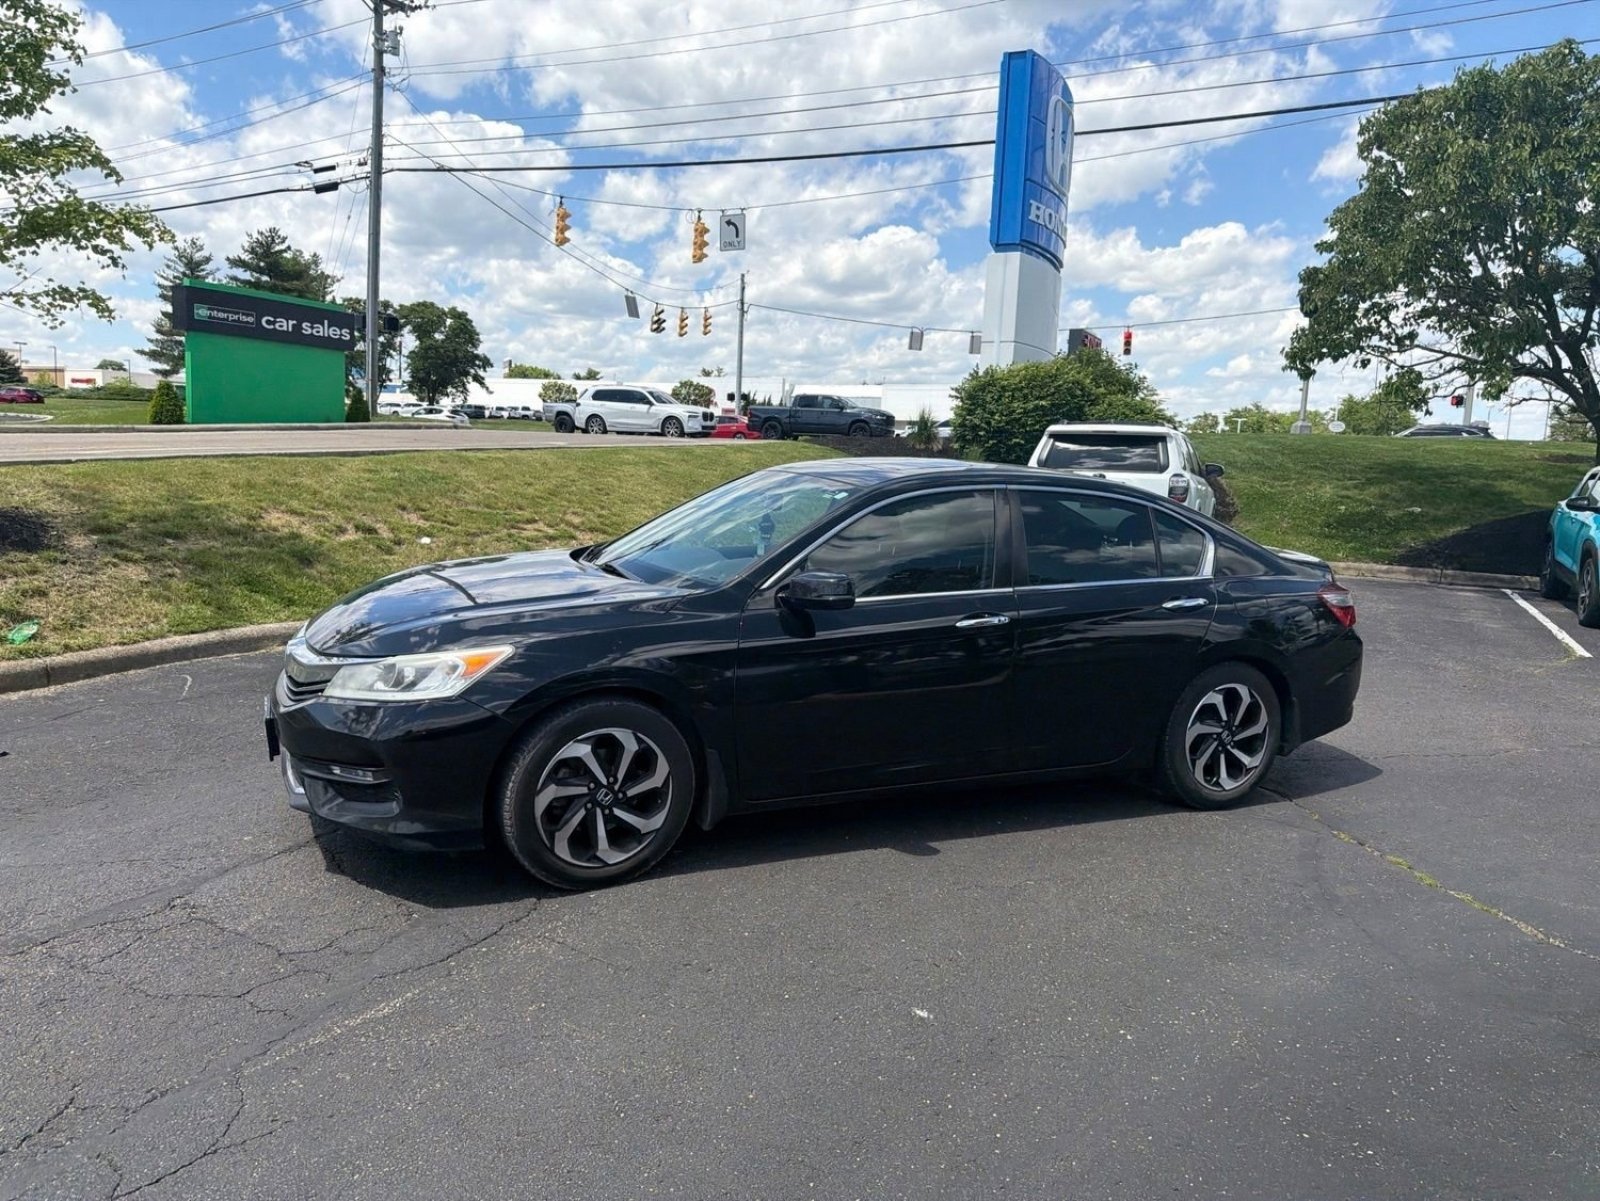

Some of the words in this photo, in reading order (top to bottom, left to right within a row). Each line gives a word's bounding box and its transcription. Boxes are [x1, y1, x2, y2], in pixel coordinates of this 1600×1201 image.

[722, 240, 742, 248] ONLY
[197, 308, 254, 323] enterprise
[261, 316, 297, 332] car
[301, 320, 351, 340] sales
